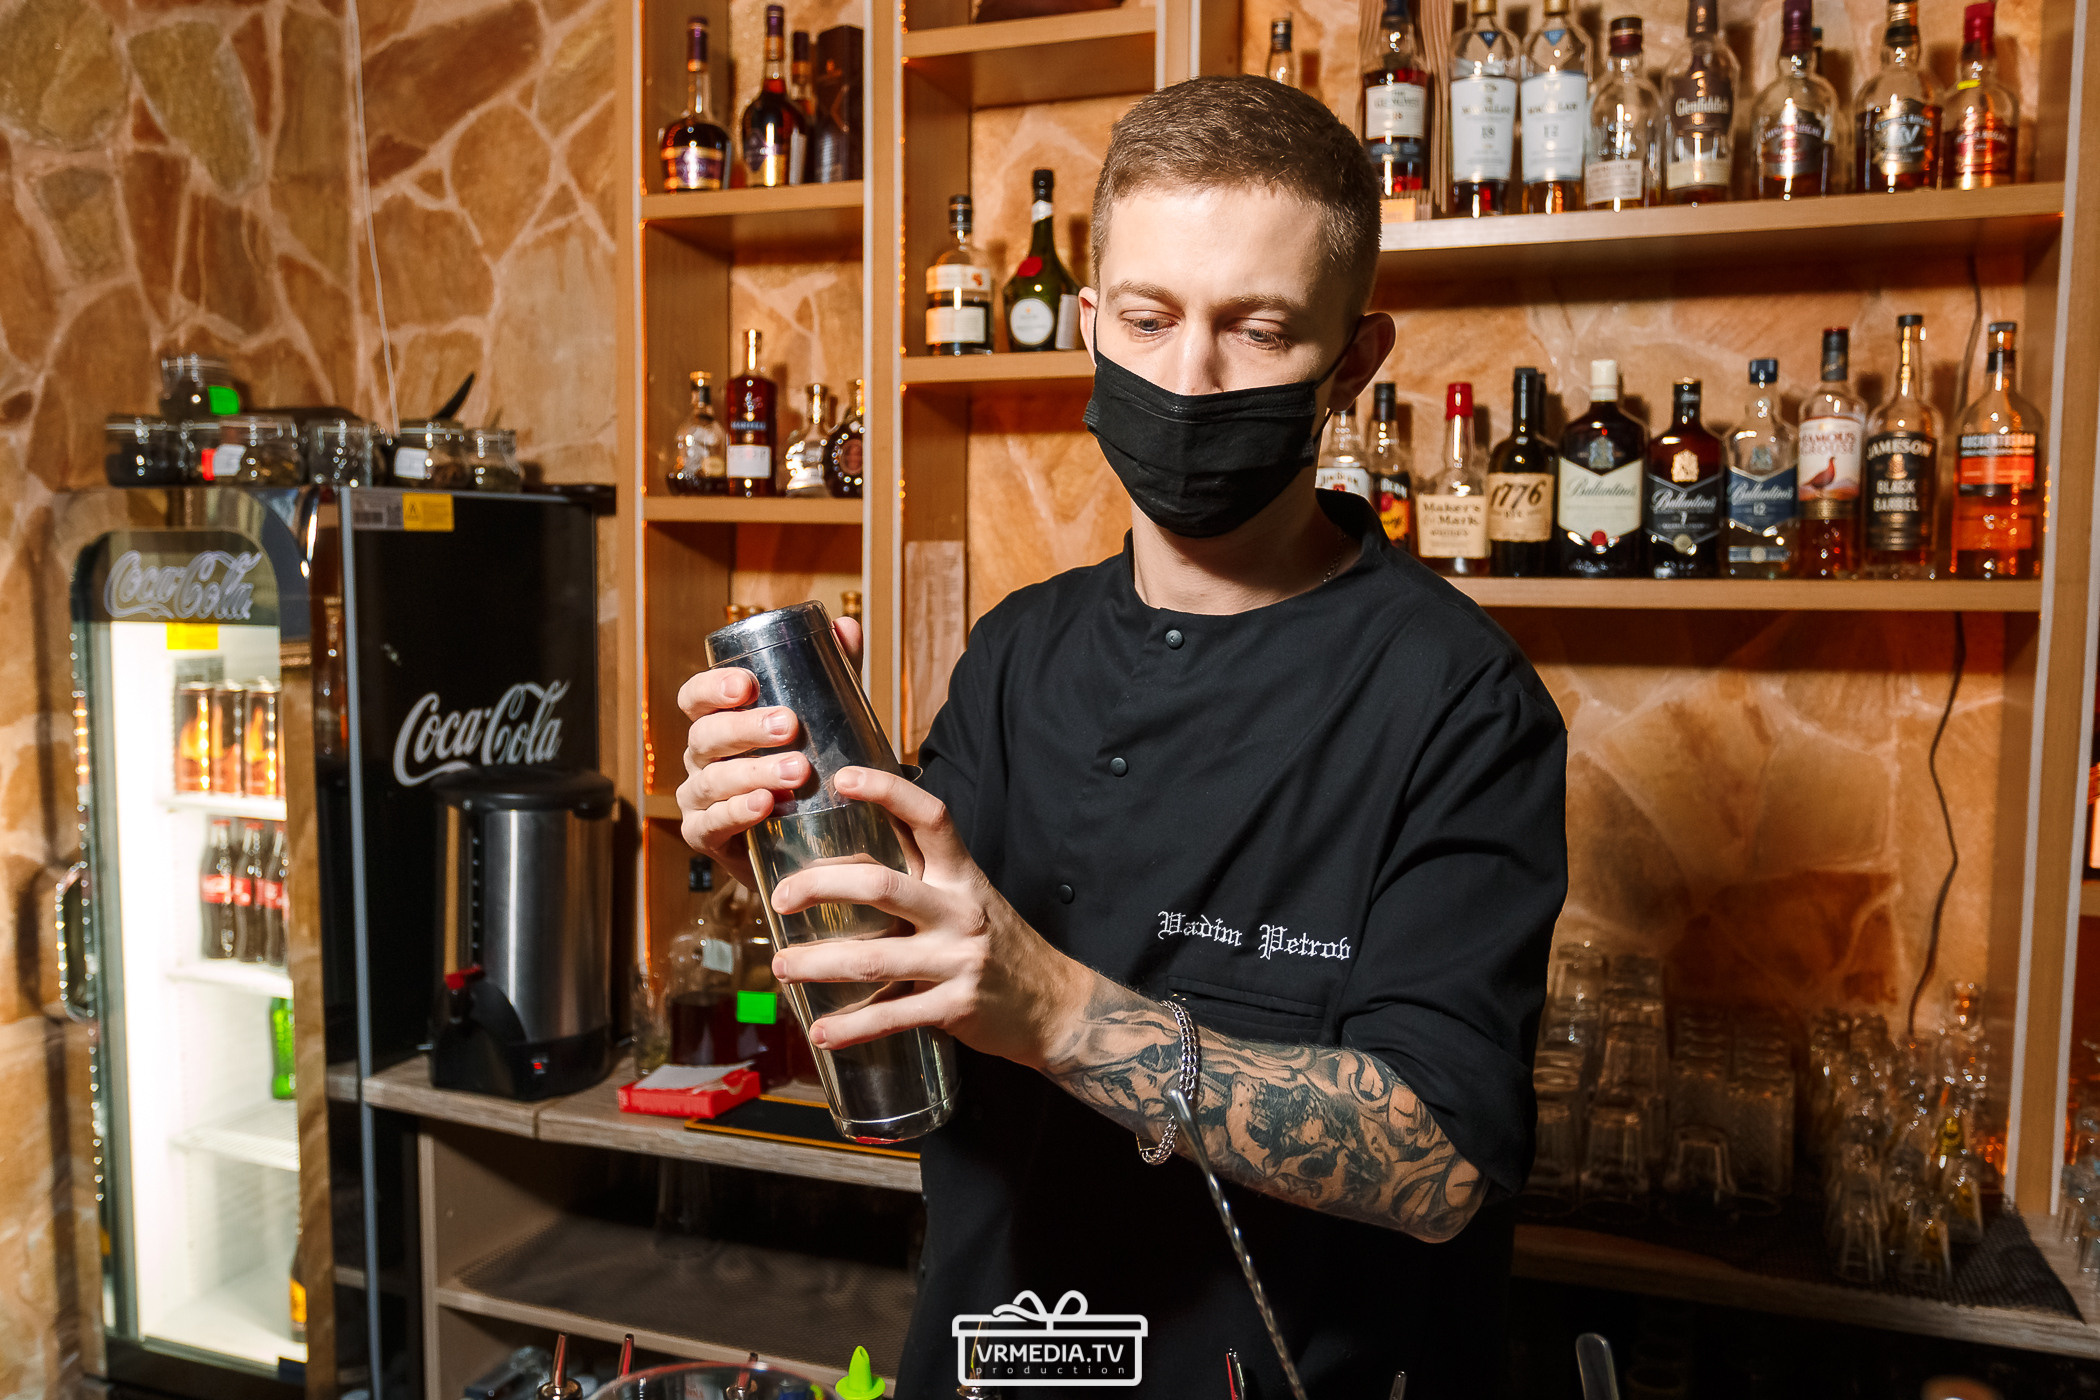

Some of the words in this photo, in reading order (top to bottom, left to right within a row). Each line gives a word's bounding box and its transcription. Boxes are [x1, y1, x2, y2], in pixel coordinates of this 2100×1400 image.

[1866, 438, 1933, 461] JAMESON
[1490, 481, 1547, 509] 1776
[1877, 478, 1916, 494] BLACK
[1873, 496, 1919, 512] BARREL
[1157, 910, 1243, 947] Vadim
[1258, 924, 1351, 960] Petrov
